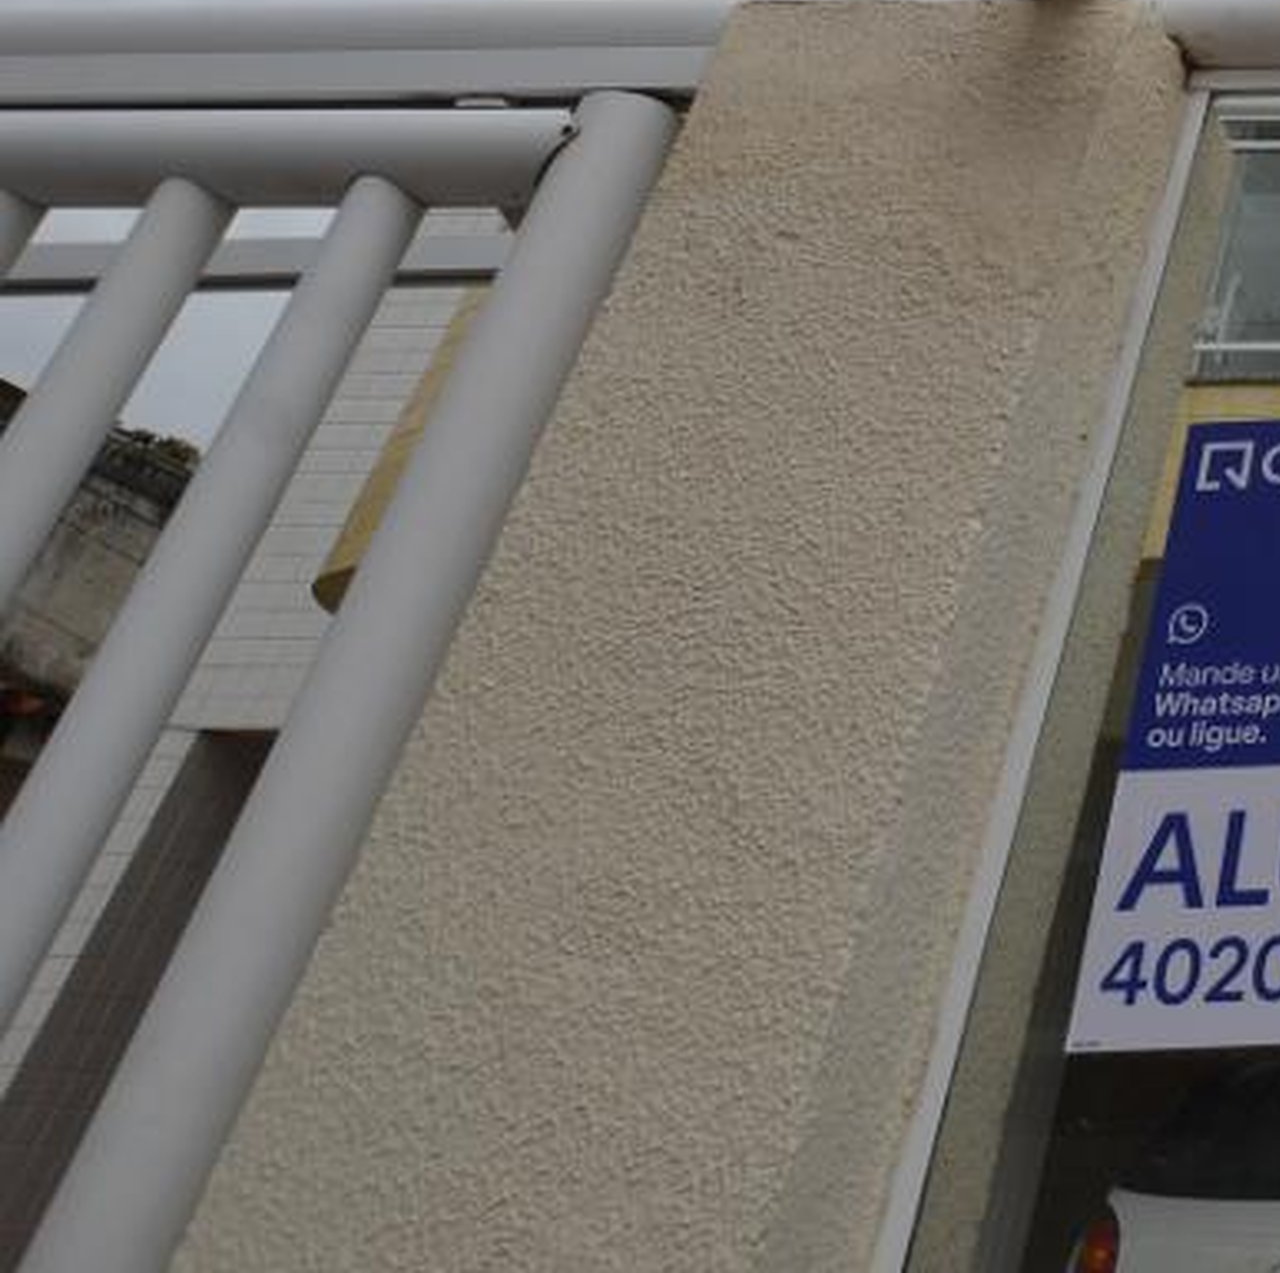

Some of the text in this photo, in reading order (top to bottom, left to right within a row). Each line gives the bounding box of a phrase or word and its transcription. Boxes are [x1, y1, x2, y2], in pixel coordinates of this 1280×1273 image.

[1158, 662, 1255, 687] Mande
[1147, 721, 1267, 753] ou ligue.
